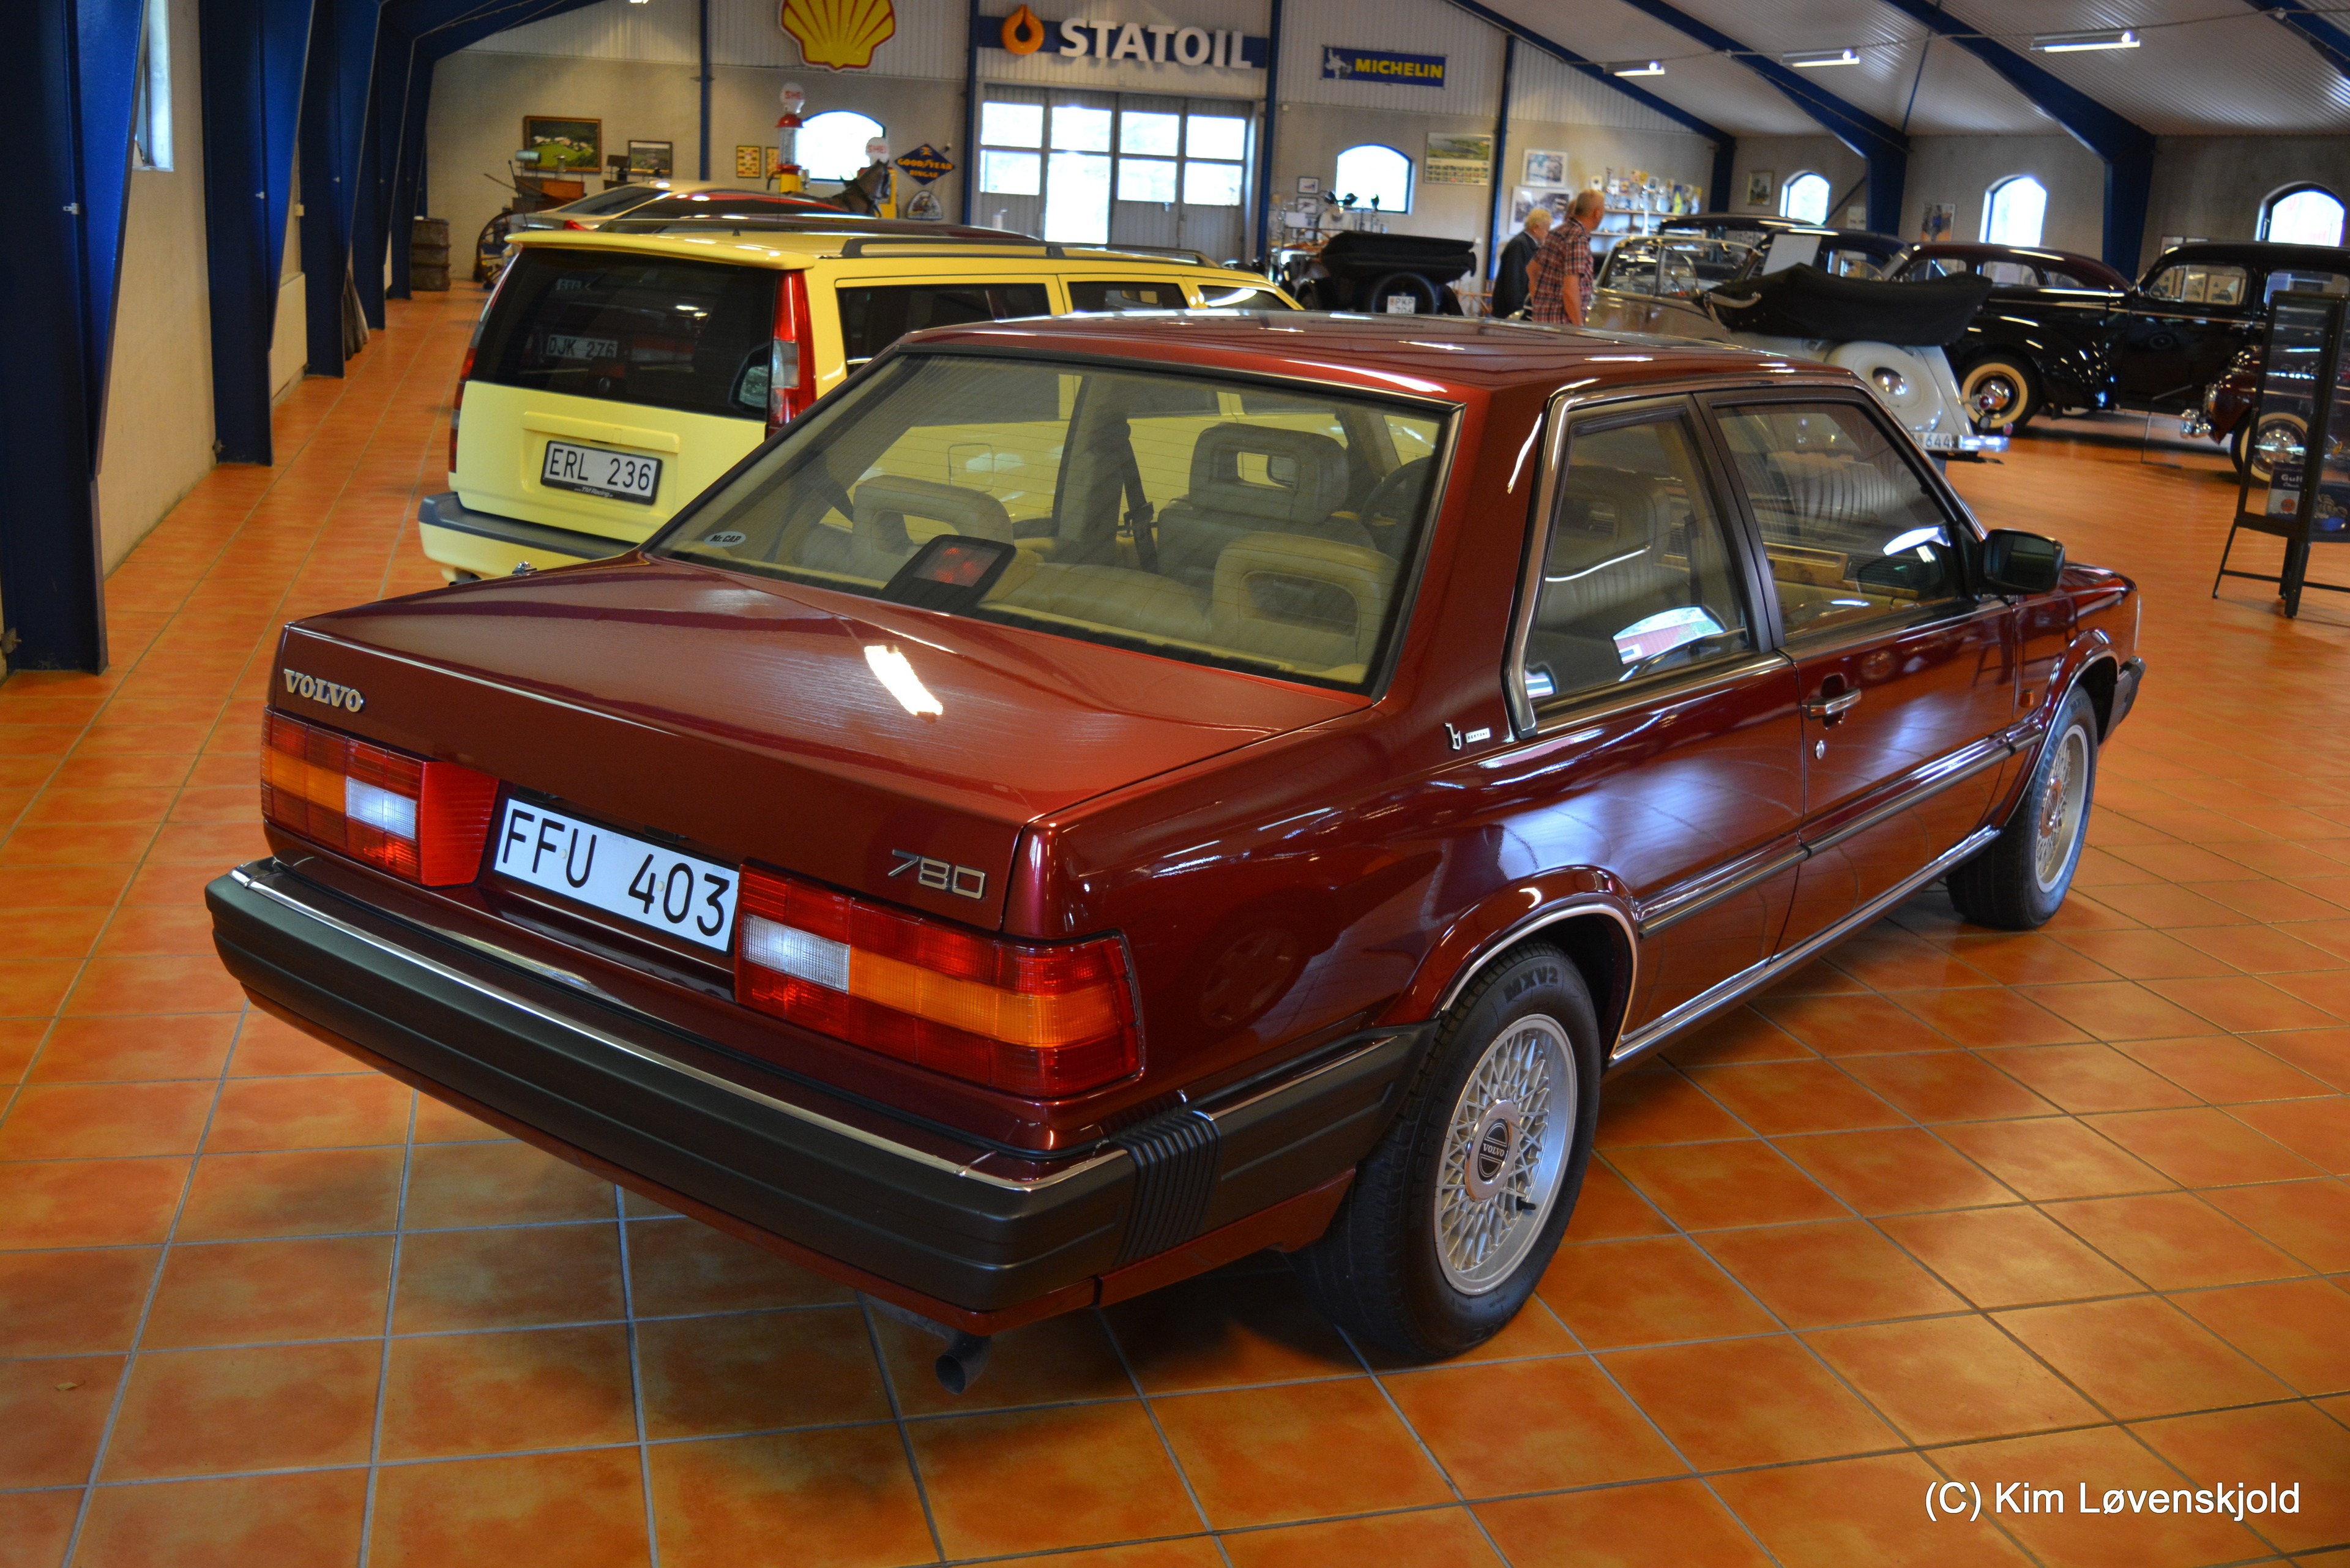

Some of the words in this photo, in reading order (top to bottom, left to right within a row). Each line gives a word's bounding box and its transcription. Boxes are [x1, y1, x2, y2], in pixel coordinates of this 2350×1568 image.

[1059, 18, 1251, 69] STATOIL
[1354, 58, 1443, 78] MICHELIN
[548, 337, 577, 356] DJK
[1925, 433, 1951, 449] 644
[549, 448, 589, 481] ERL
[606, 458, 652, 491] 236
[283, 668, 364, 712] VOLVO
[502, 808, 597, 888] FFU
[628, 853, 730, 936] 403
[888, 849, 985, 900] 780
[1502, 965, 1559, 1004] MXV2
[1483, 1143, 1505, 1157] VOLVO
